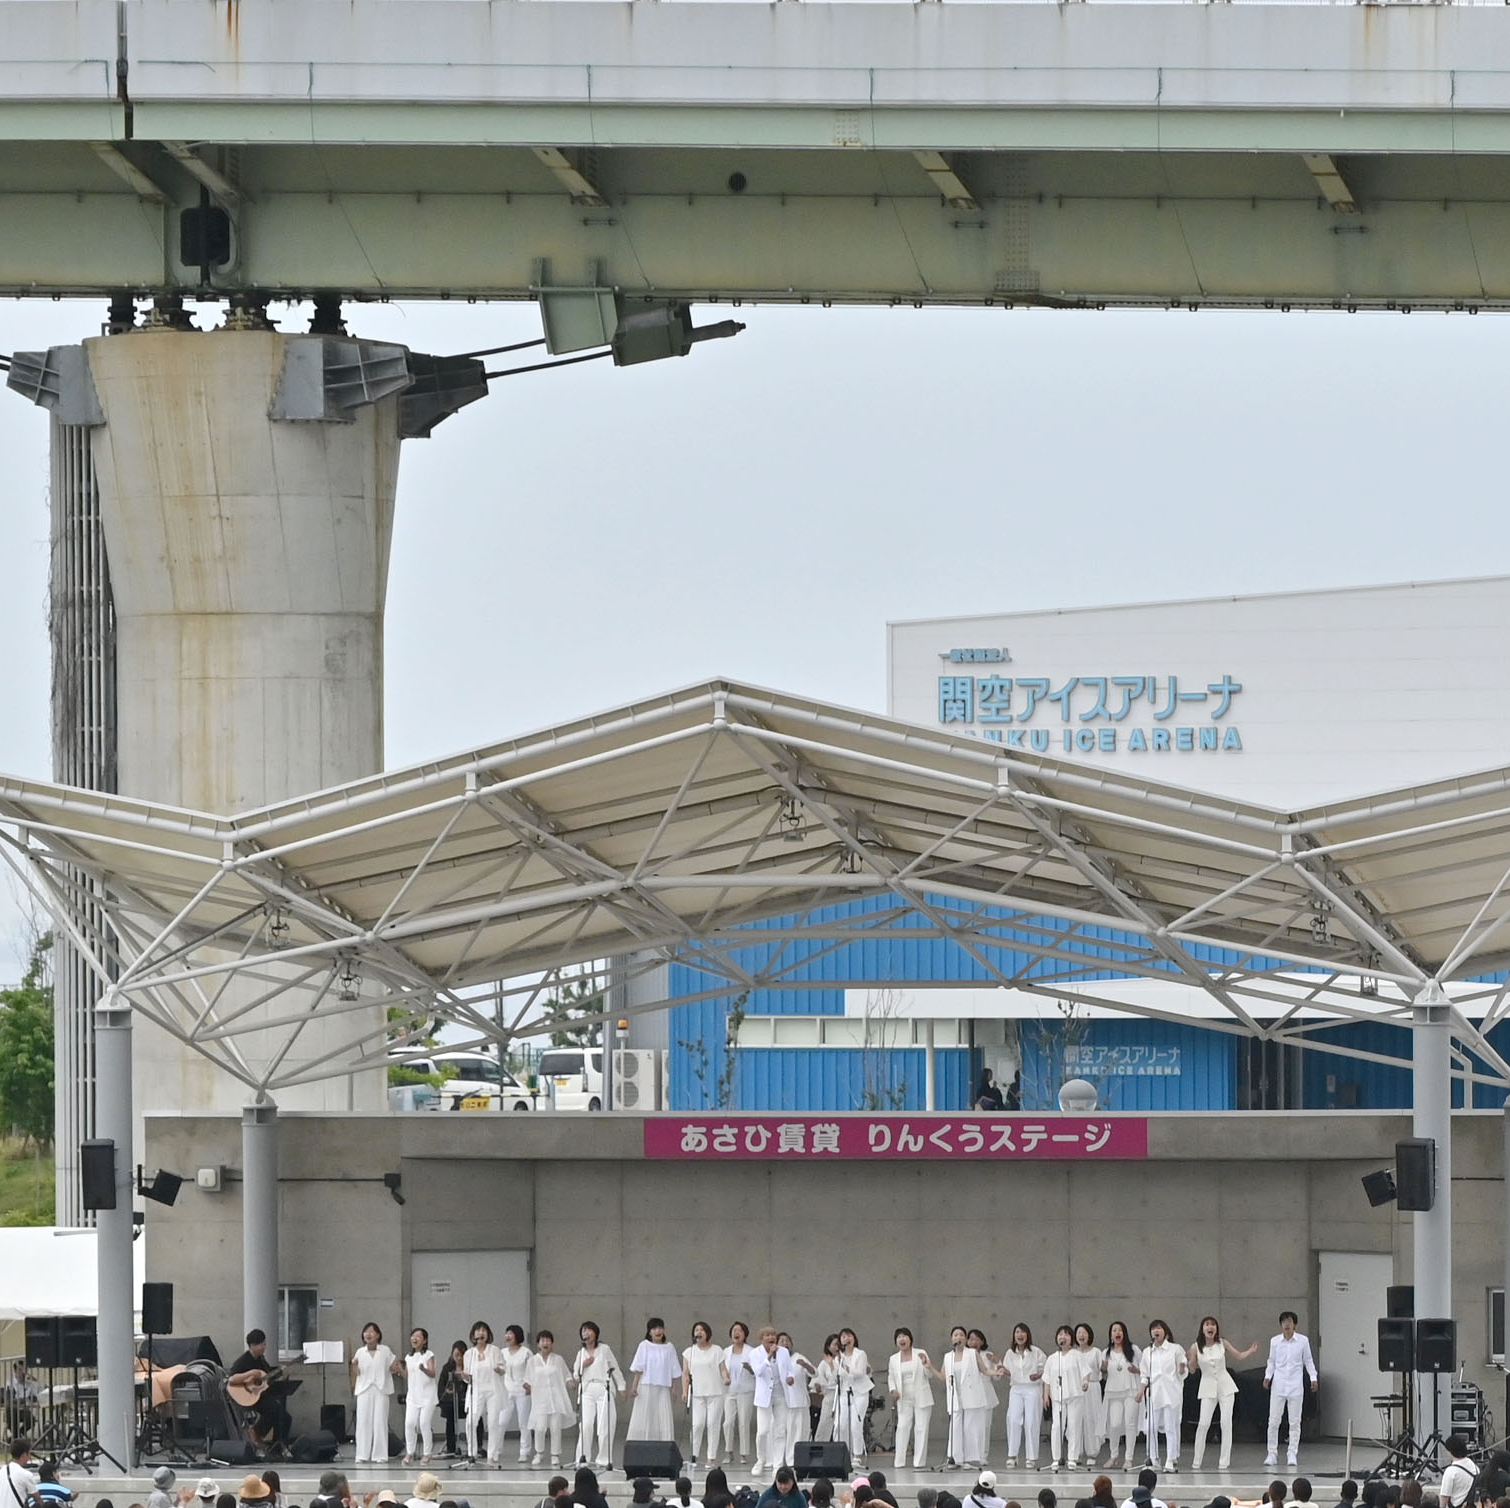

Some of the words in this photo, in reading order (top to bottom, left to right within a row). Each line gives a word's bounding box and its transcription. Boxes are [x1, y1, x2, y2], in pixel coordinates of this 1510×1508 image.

[938, 674, 1243, 723] 関空アイスアリーナ
[1062, 728, 1117, 751] ICE
[1128, 727, 1243, 750] ARENA
[1064, 1045, 1181, 1064] 関空アイスアリーナ
[1138, 1066, 1181, 1076] ARENA
[680, 1124, 841, 1154] あさひ賃貸
[867, 1123, 1113, 1154] りんくうステージ
